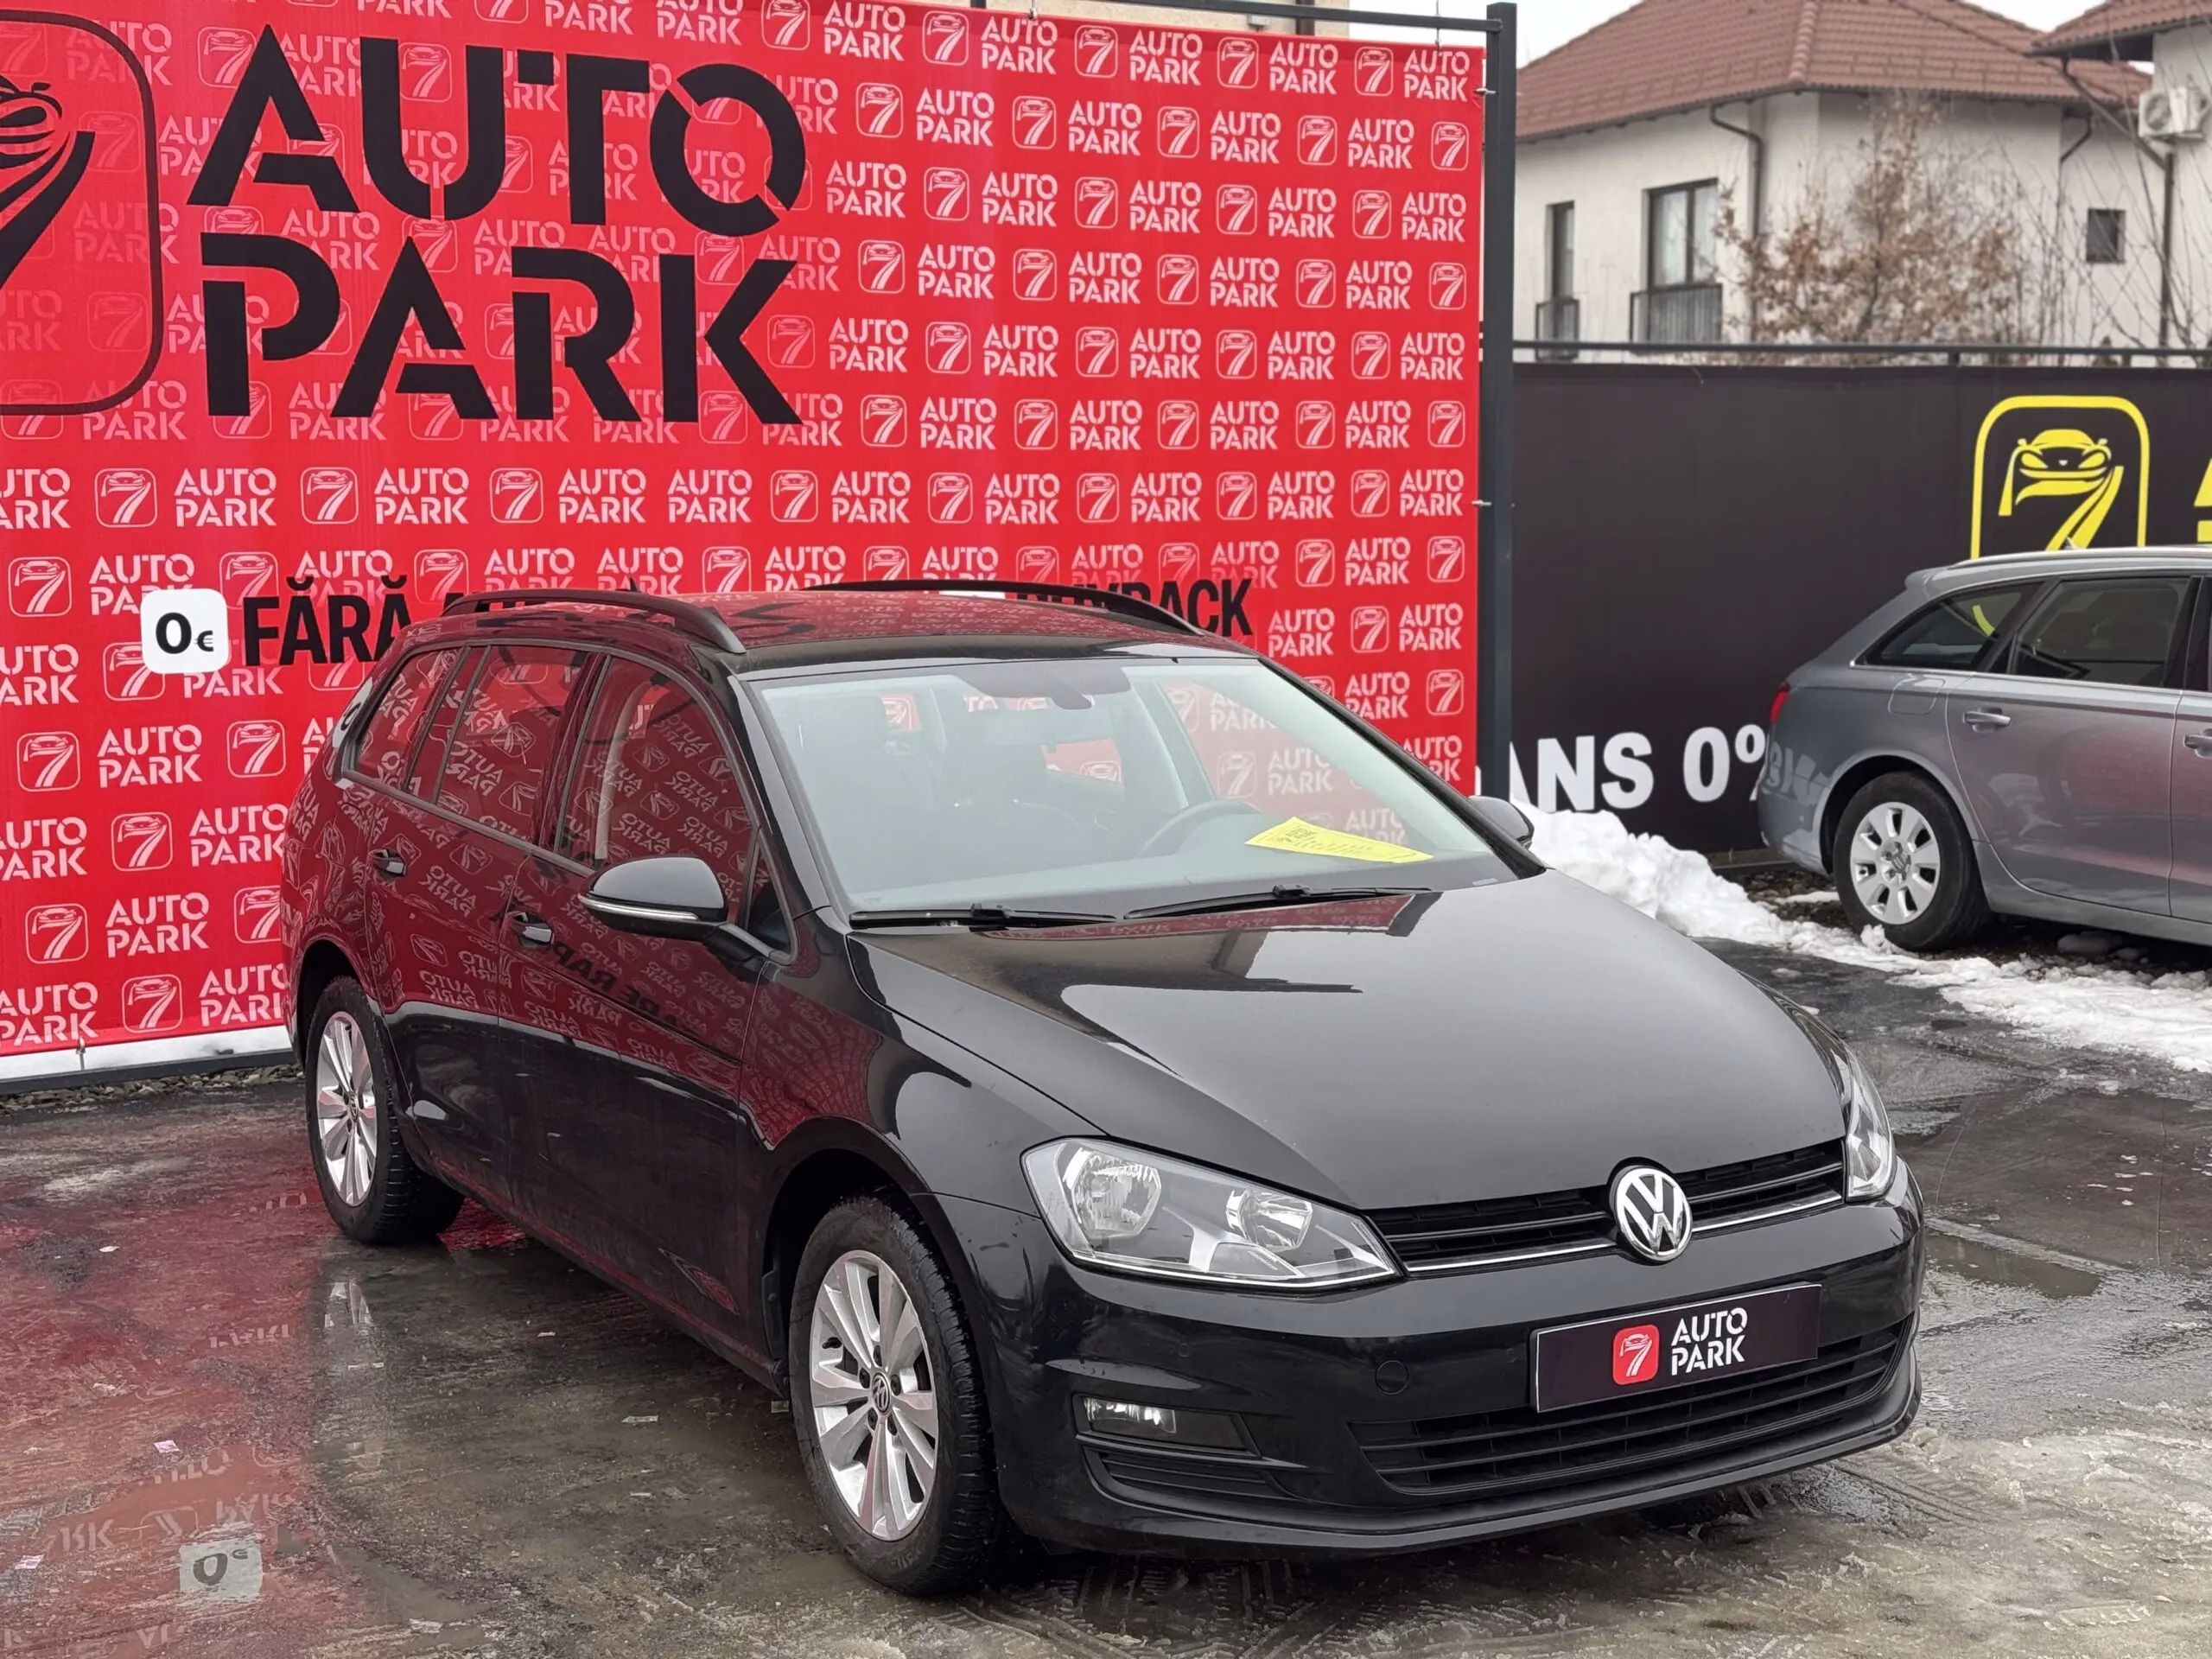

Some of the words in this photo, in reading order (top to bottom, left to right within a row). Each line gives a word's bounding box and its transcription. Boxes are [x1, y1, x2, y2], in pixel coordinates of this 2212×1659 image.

[544, 3, 634, 35] PARK
[658, 10, 741, 44] PARK
[823, 1, 905, 32] AUTO
[824, 28, 903, 60] PARK
[981, 16, 1058, 46] AUTO
[1129, 30, 1202, 59] AUTO
[982, 42, 1056, 74] PARK
[1269, 41, 1338, 68] AUTO
[1403, 50, 1470, 74] AUTO
[1130, 55, 1200, 86] PARK
[1270, 67, 1336, 94] PARK
[776, 74, 839, 105] UTO
[1405, 74, 1467, 101] PARK
[916, 88, 994, 118] AUTO
[1068, 100, 1141, 129] AUTO
[187, 23, 807, 238] AUTO
[917, 115, 993, 146] PARK
[1211, 111, 1281, 137] AUTO
[1348, 118, 1414, 143] AUTO
[1069, 126, 1141, 156] PARK
[1211, 136, 1279, 163] PARK
[1348, 143, 1412, 168] PARK
[826, 161, 906, 190] AUTO
[982, 172, 1058, 200] AUTO
[828, 188, 906, 218] PARK
[1129, 181, 1201, 207] AUTO
[1268, 188, 1336, 213] AUTO
[1402, 193, 1465, 217] AUTO
[280, 209, 379, 239] AUTO
[982, 198, 1056, 226] PARK
[1130, 206, 1199, 232] PARK
[1268, 212, 1334, 238] PARK
[474, 218, 565, 248] AUTO
[588, 226, 675, 254] AUTO
[1402, 216, 1465, 242] PARK
[759, 234, 841, 263] AUTO
[918, 244, 995, 272] AUTO
[777, 262, 841, 292] ARK
[1069, 251, 1141, 277] AUTO
[1210, 257, 1279, 282] AUTO
[1346, 261, 1412, 284] AUTO
[918, 270, 994, 299] PARK
[1070, 277, 1140, 303] PARK
[1211, 282, 1277, 308] PARK
[1346, 285, 1410, 309] PARK
[199, 232, 804, 425] PARK
[830, 318, 908, 345] AUTO
[983, 325, 1058, 351] AUTO
[1130, 328, 1201, 353] AUTO
[1268, 331, 1335, 355] AUTO
[1401, 333, 1465, 356] AUTO
[830, 345, 907, 372] PARK
[984, 350, 1058, 377] PARK
[1130, 353, 1199, 378] PARK
[1268, 355, 1333, 379] PARK
[1402, 356, 1463, 380] PARK
[919, 397, 996, 423] AUTO
[1070, 400, 1142, 424] AUTO
[1210, 401, 1279, 424] AUTO
[1345, 400, 1410, 423] AUTO
[83, 411, 188, 441] PARK
[289, 410, 387, 441] PARK
[480, 415, 569, 442] PARK
[594, 415, 681, 443] PARK
[762, 421, 842, 447] PARK
[921, 423, 995, 449] PARK
[1071, 425, 1141, 449] PARK
[1211, 426, 1277, 449] PARK
[1346, 424, 1409, 448] PARK
[0, 468, 70, 498] UTO
[175, 468, 276, 496] AUTO
[374, 467, 468, 494] AUTO
[558, 468, 646, 495] AUTO
[668, 470, 752, 495] AUTO
[831, 472, 911, 497] AUTO
[985, 474, 1059, 498] AUTO
[1131, 473, 1202, 497] AUTO
[1268, 471, 1335, 494] AUTO
[1400, 469, 1464, 493] AUTO
[0, 499, 70, 529] ARK
[176, 498, 276, 526] PARK
[376, 497, 468, 524] PARK
[560, 497, 645, 523] PARK
[669, 497, 751, 523] PARK
[833, 498, 909, 523] PARK
[986, 499, 1058, 524] PARK
[1131, 497, 1200, 522] PARK
[1268, 495, 1333, 519] PARK
[1401, 493, 1462, 516] PARK
[485, 548, 575, 575] AUTO
[597, 547, 683, 573] AUTO
[765, 546, 846, 571] AUTO
[922, 546, 998, 571] AUTO
[1071, 543, 1143, 569] AUTO
[1211, 541, 1279, 565] AUTO
[1344, 537, 1410, 562] AUTO
[89, 554, 194, 584] AUTO
[296, 550, 392, 578] AUTO
[1345, 561, 1408, 586] PARK
[243, 575, 413, 666] FĂRĂ
[1268, 608, 1334, 632] AUTO
[1399, 603, 1463, 627] AUTO
[1268, 632, 1334, 658] PARK
[1400, 626, 1461, 652] PARK
[0, 644, 79, 675] UTO
[0, 675, 79, 705] ARK
[184, 669, 282, 697] PARK
[1344, 671, 1410, 697] AUTO
[98, 724, 201, 757] AUTO
[99, 754, 201, 788] PARK
[1268, 770, 1333, 796] PARK
[0, 817, 86, 849] UTO
[189, 804, 288, 836] AUTO
[191, 832, 286, 866] PARK
[0, 847, 86, 880] ARK
[105, 893, 209, 927] AUTO
[107, 922, 208, 957] PARK
[1670, 1306, 1749, 1347] AUTO
[1670, 1335, 1745, 1376] PARK
